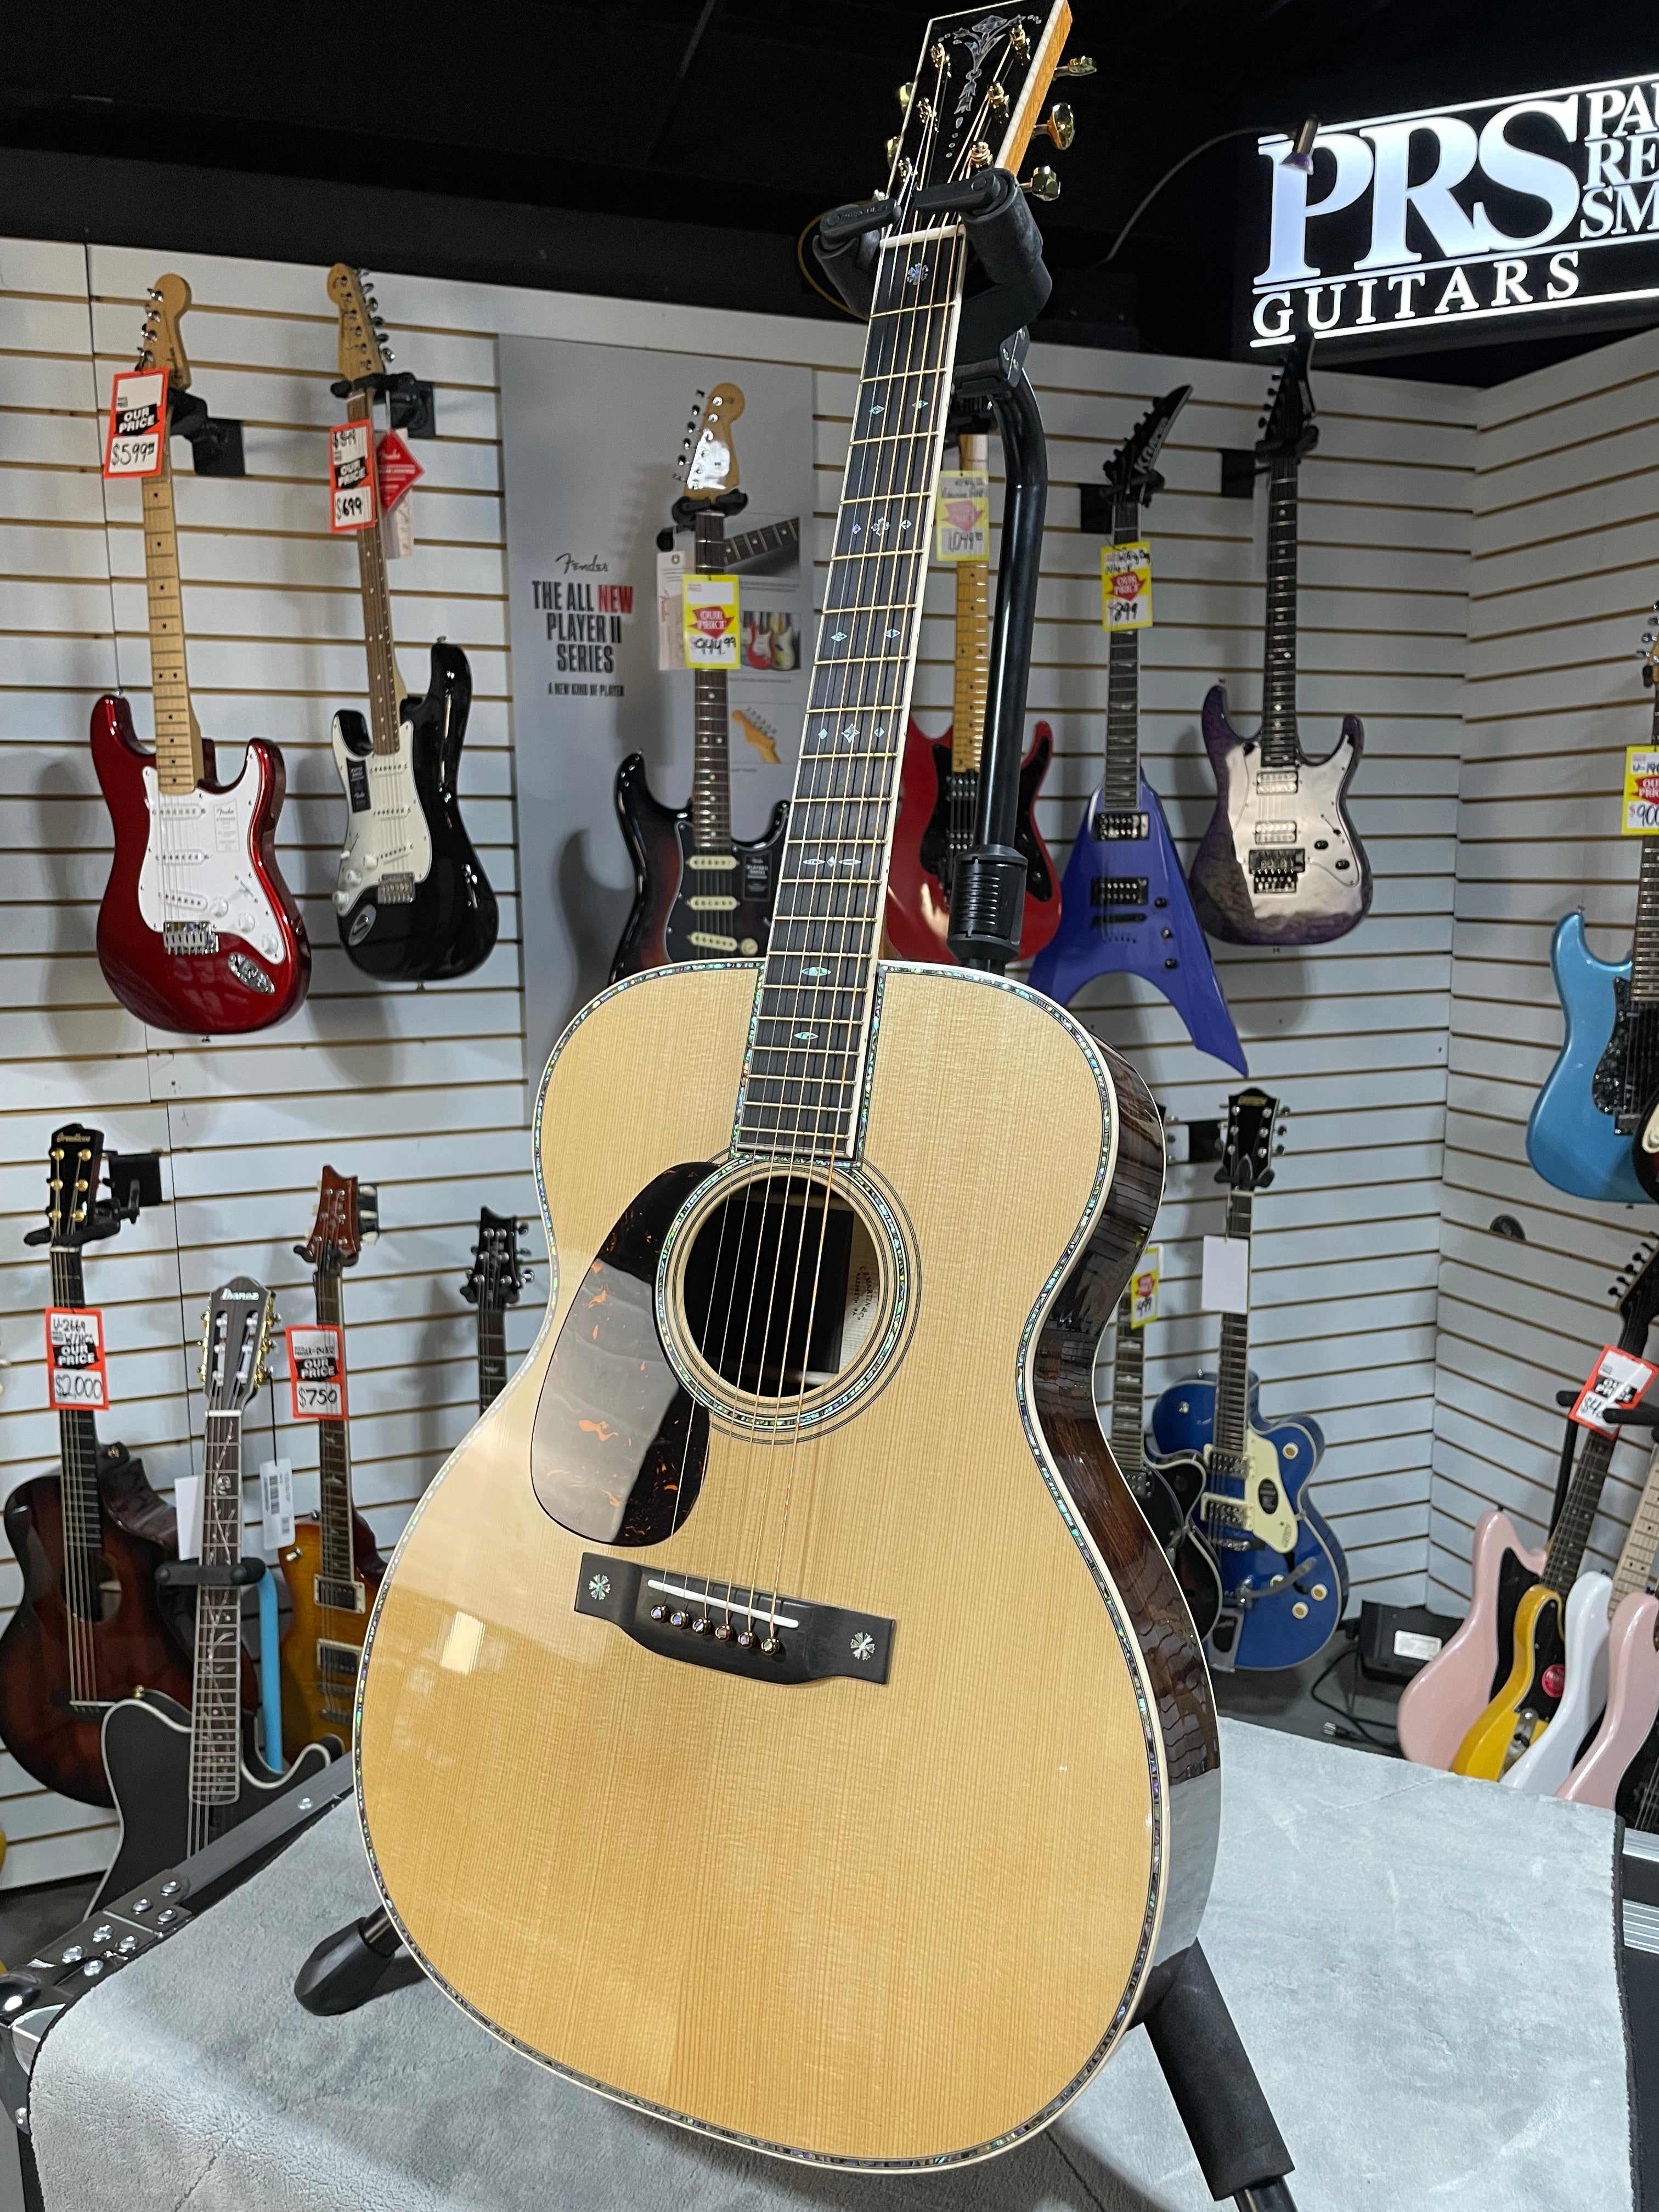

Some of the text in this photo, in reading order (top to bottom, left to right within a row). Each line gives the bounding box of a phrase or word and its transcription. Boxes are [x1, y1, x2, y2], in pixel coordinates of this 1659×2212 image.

[1584, 82, 1659, 142] PA
[1253, 94, 1580, 285] PRS
[1252, 251, 1579, 338] GUITARS
[123, 407, 150, 422] OUR
[119, 415, 155, 433] PRICE
[555, 552, 609, 574] Fender
[1116, 575, 1138, 585] OUR
[532, 580, 562, 610] THE
[567, 583, 595, 612] ALL
[598, 584, 634, 614] NEW
[1114, 584, 1140, 595] PRICE
[699, 610, 724, 620] OUR
[546, 612, 622, 644] PLAYER II
[697, 620, 726, 630] PRICE
[557, 644, 614, 673] SERIES
[60, 1344, 88, 1356] OUR
[58, 1352, 95, 1367] PRICE
[304, 1358, 329, 1369] OUR
[301, 1365, 335, 1379] PRICE
[55, 1374, 103, 1400] $2,000
[298, 1386, 337, 1408] $750
